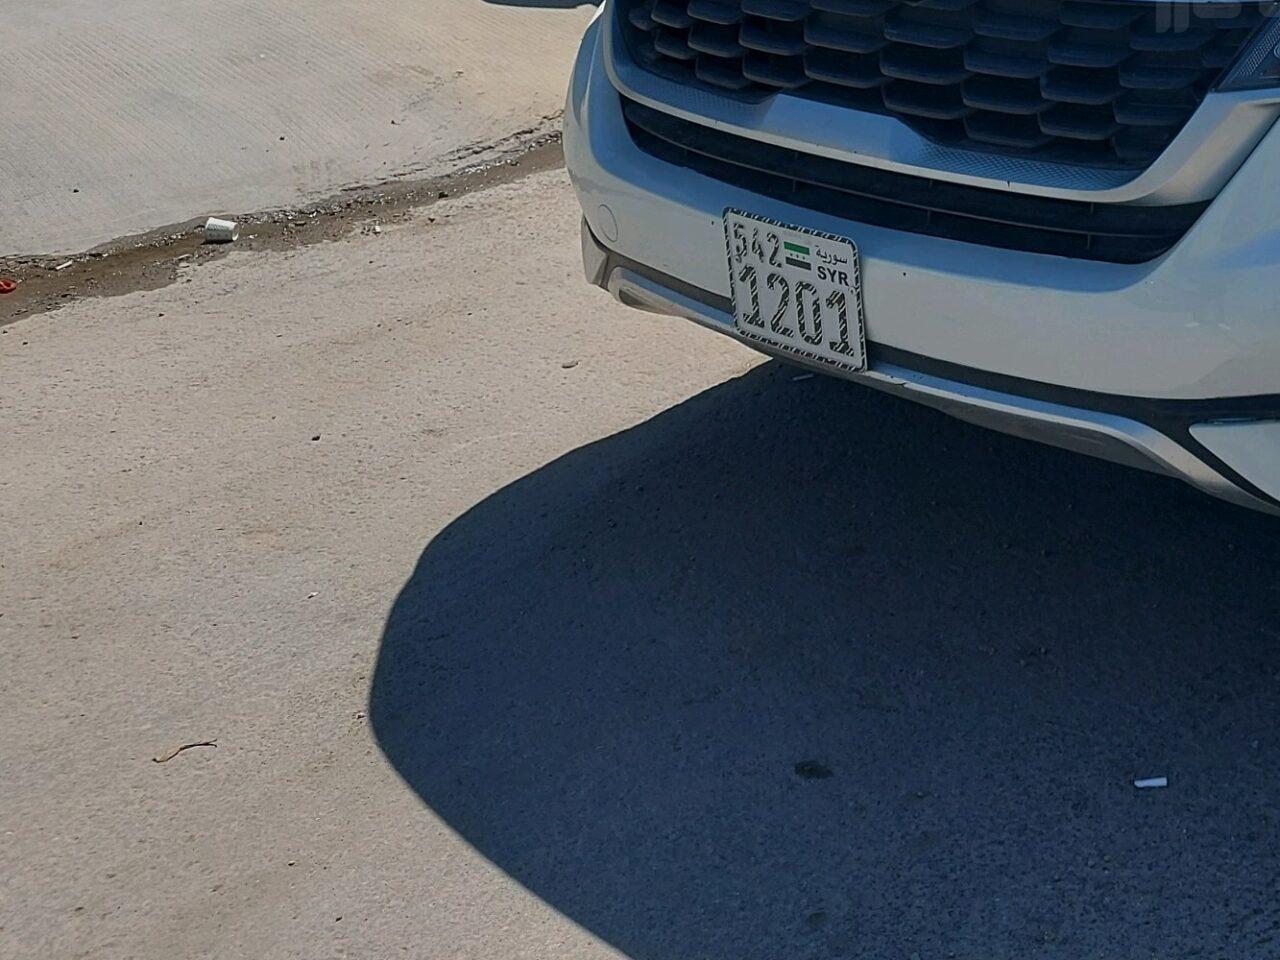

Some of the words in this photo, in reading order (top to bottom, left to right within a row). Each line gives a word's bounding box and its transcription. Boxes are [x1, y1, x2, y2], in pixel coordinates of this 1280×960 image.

[733, 222, 783, 269] 542
[814, 244, 849, 267] سورية
[816, 265, 850, 287] SYR
[738, 264, 855, 357] 1201
